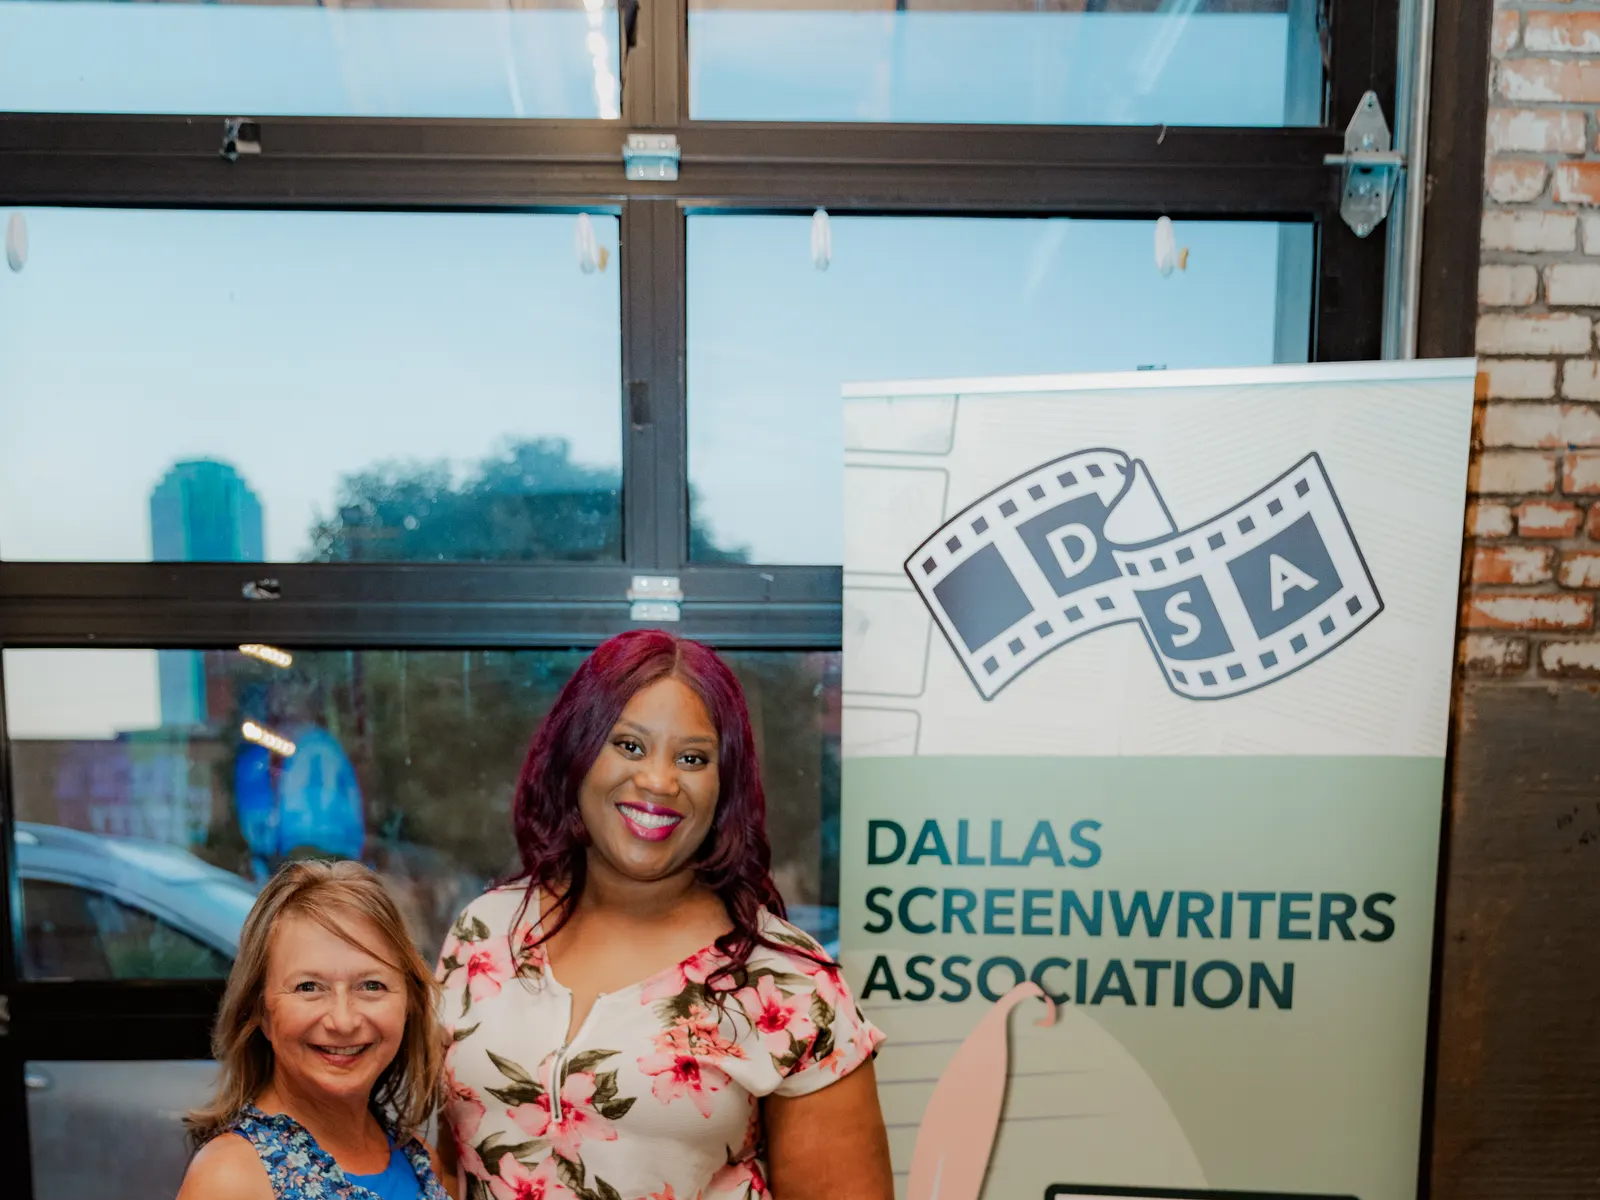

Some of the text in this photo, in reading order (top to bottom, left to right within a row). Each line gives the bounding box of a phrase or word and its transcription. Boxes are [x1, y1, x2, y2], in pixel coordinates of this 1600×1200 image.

[866, 819, 1102, 868] DALLAS
[863, 886, 1396, 943] SCREENWRITERS
[860, 955, 1295, 1010] ASSOCIATION
